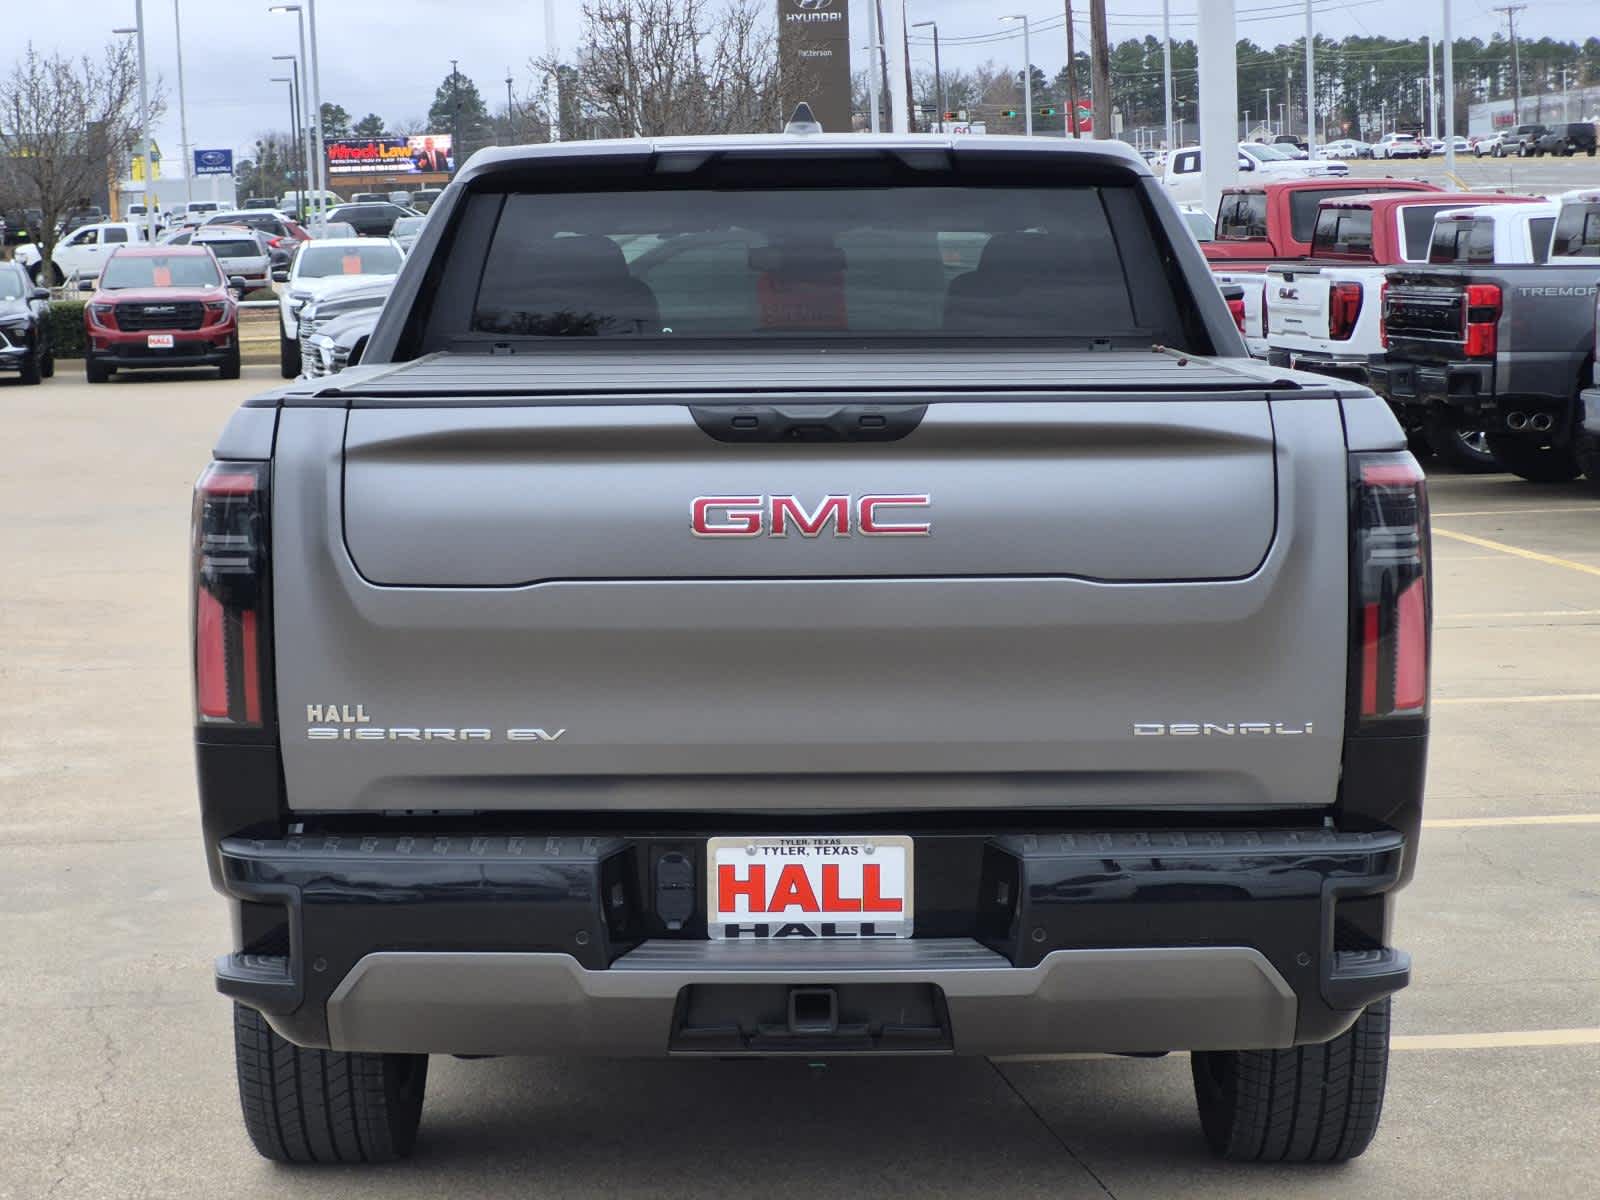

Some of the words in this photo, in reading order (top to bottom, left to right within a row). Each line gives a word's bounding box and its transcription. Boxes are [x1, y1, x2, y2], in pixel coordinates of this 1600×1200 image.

[786, 12, 842, 22] HYUNDAI
[690, 493, 931, 538] GMC
[306, 703, 371, 724] HALL
[307, 727, 492, 741] SIERRA
[506, 727, 567, 741] EV
[1133, 721, 1313, 737] DENALI
[762, 846, 810, 857] TYLER,
[814, 846, 859, 856] TEXAS
[717, 863, 903, 913] HALL
[724, 922, 897, 938] HALL
